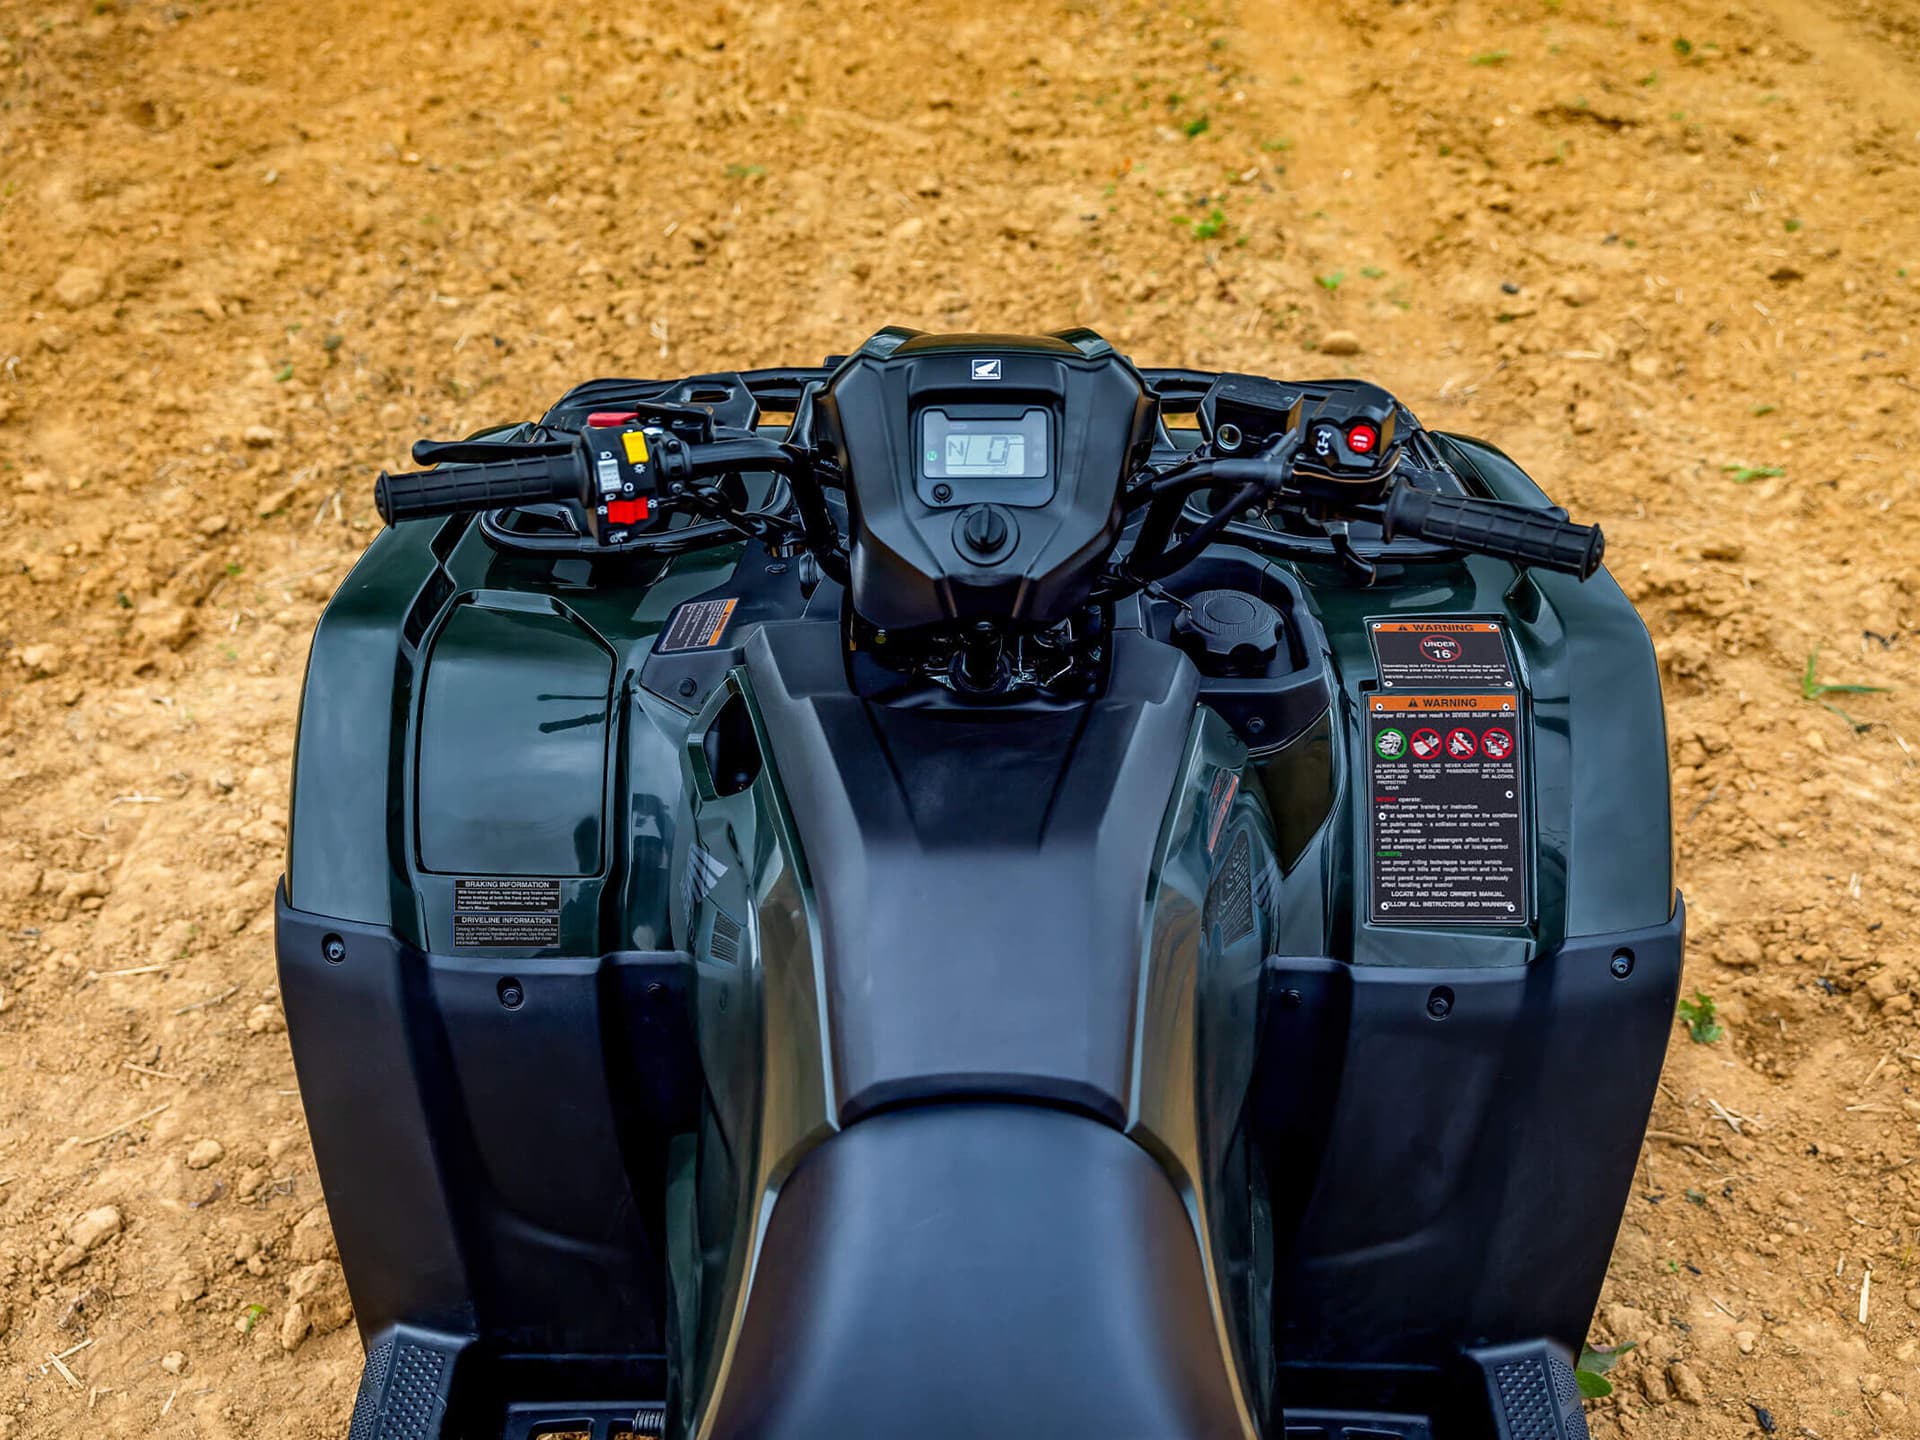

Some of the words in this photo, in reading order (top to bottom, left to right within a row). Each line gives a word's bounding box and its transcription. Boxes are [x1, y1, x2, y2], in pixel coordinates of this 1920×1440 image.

[948, 440, 964, 456] N
[987, 437, 1008, 462] 0
[1433, 650, 1452, 659] 16
[1422, 699, 1477, 707] WARNING
